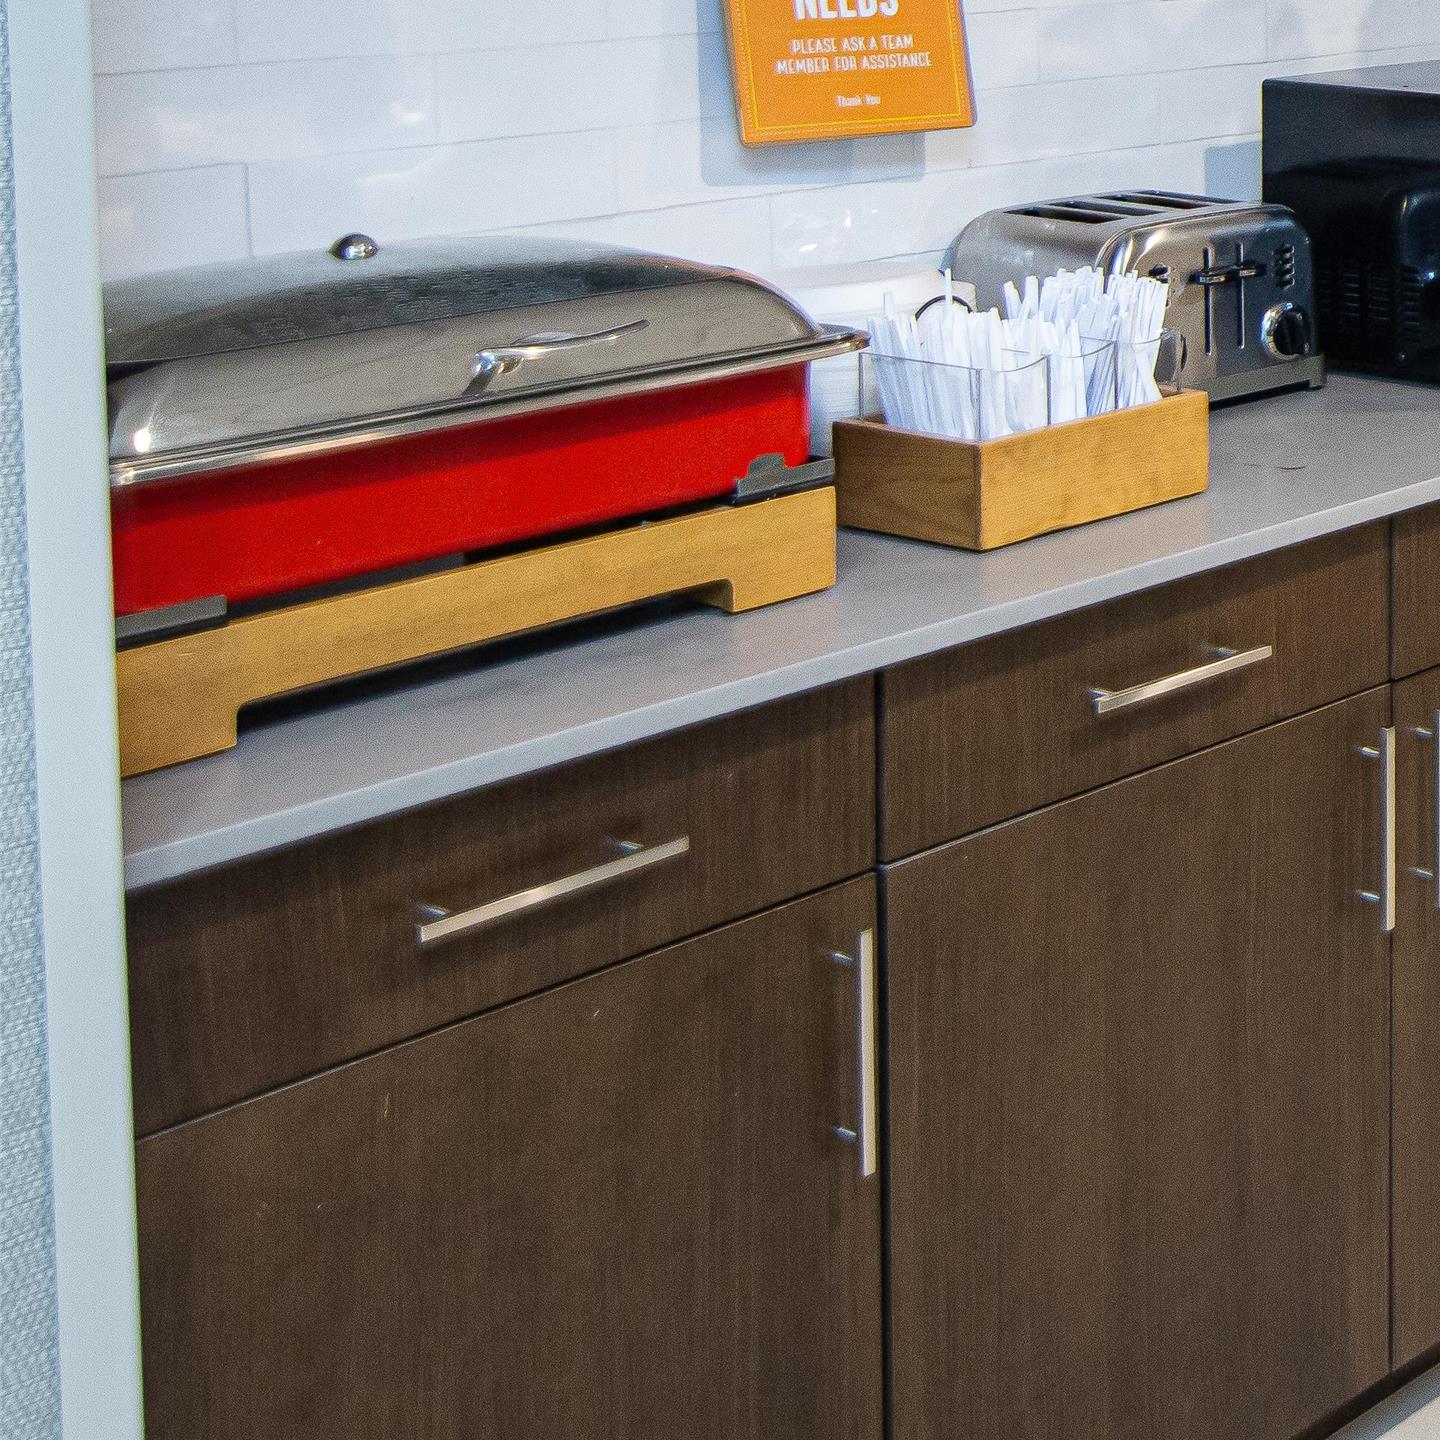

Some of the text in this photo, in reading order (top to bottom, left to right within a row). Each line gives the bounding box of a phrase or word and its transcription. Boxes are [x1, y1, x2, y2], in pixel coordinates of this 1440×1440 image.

[790, 34, 913, 54] PLEASE ASK A TEAM
[776, 52, 932, 74] MEMBER FOR ASSISTANCE
[836, 94, 881, 107] Thank You
